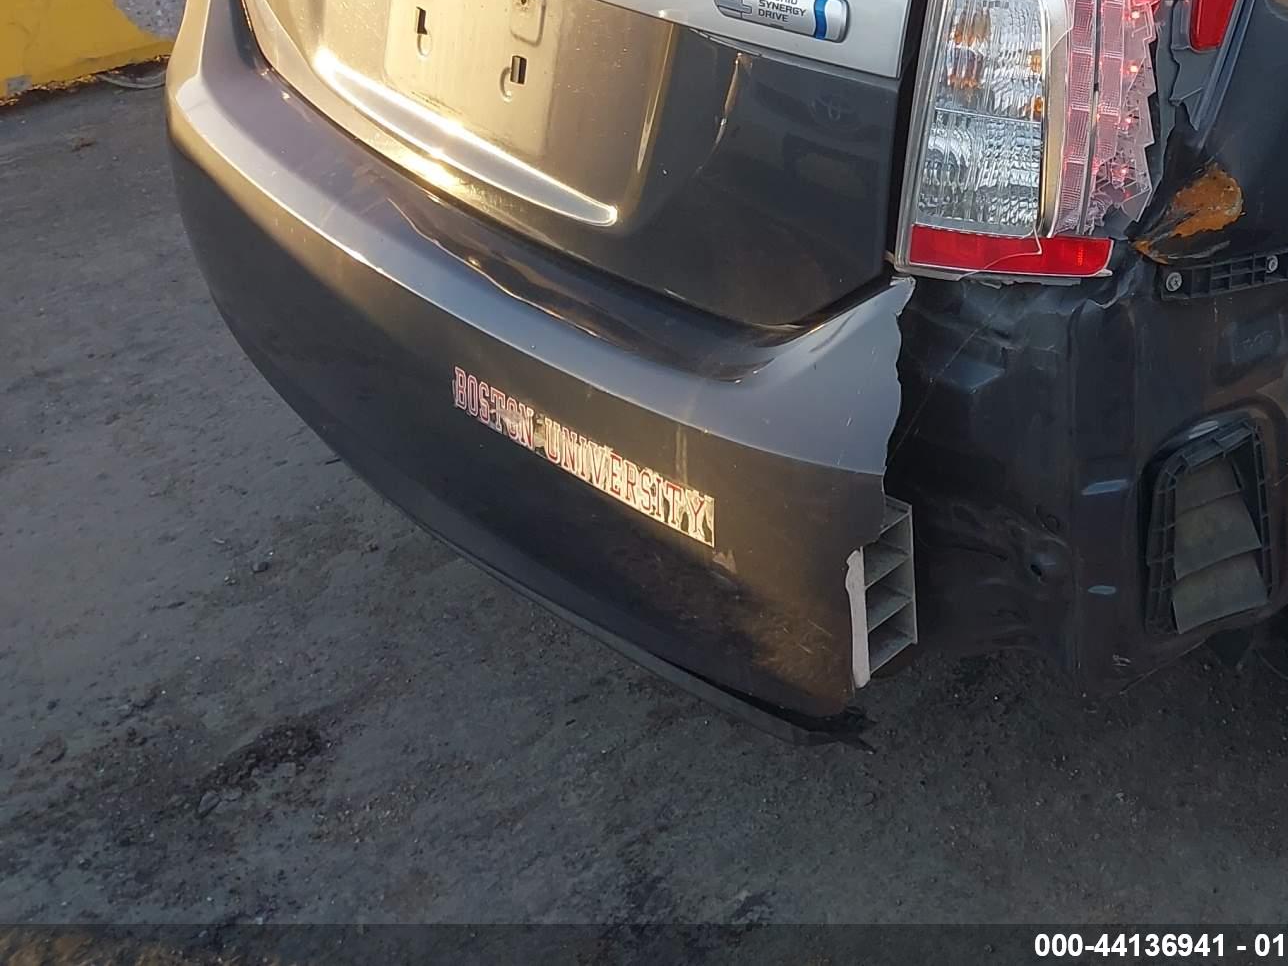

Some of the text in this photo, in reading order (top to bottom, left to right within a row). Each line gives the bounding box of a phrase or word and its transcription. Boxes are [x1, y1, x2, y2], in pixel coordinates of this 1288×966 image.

[758, 0, 807, 17] SYNERGY
[758, 8, 789, 23] DRIVE
[454, 366, 713, 540] BOSTON UNIVERSITY
